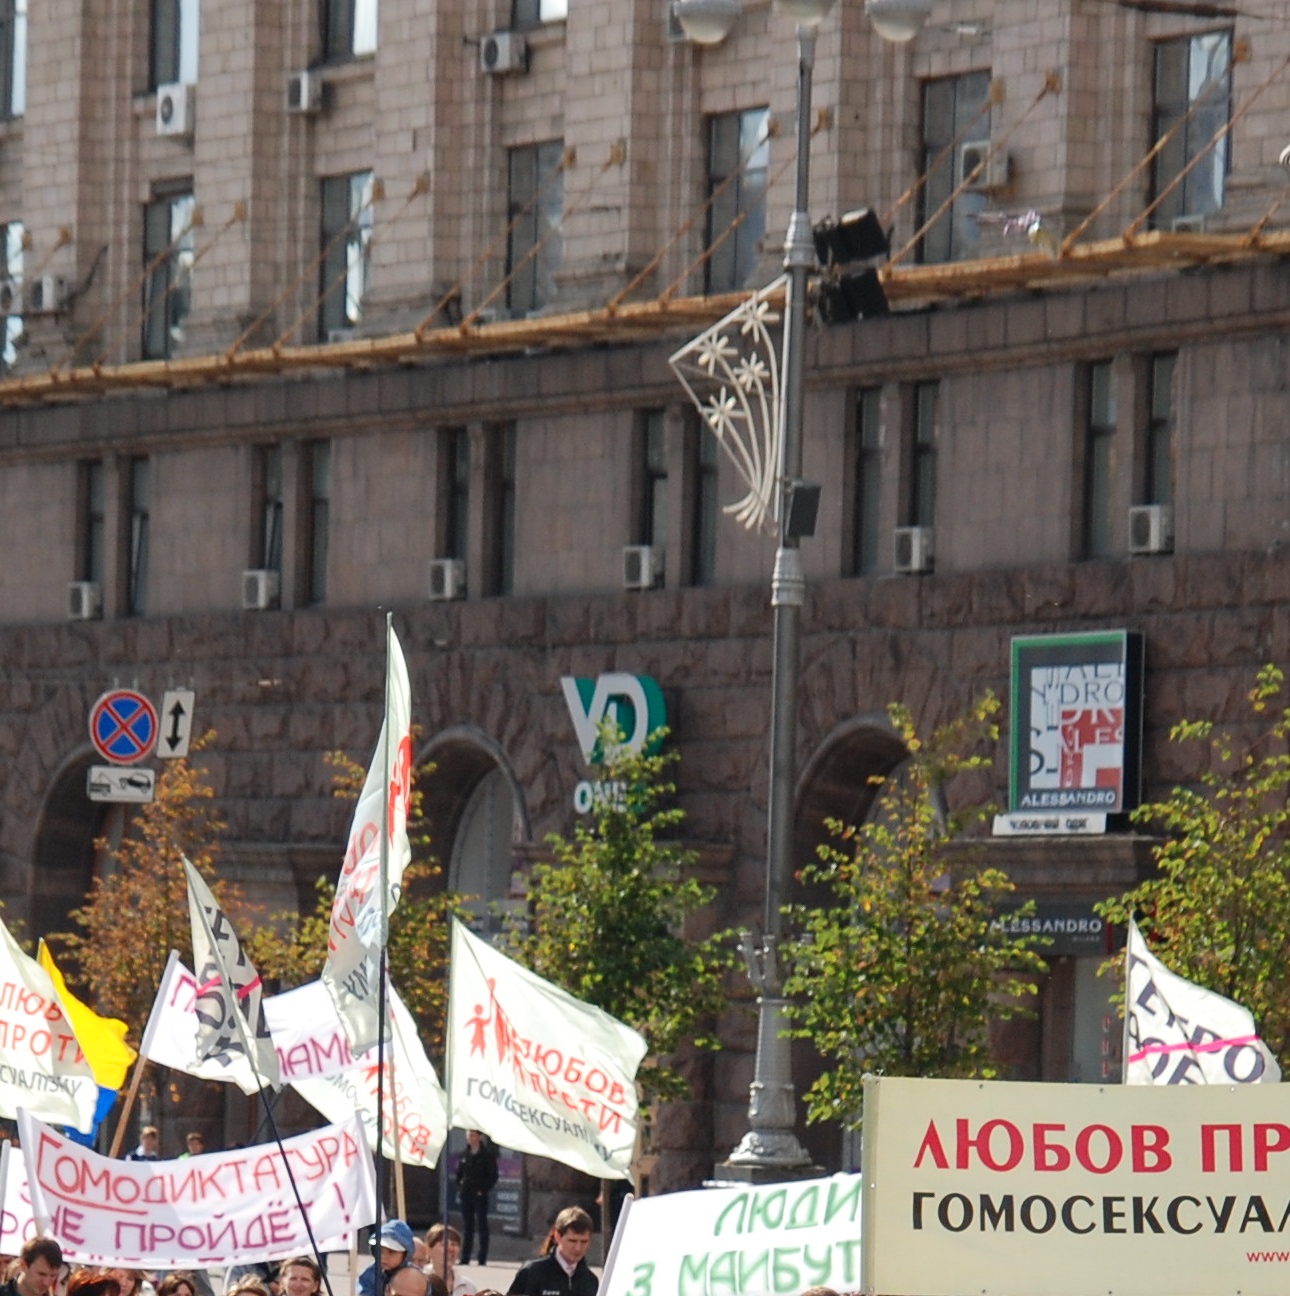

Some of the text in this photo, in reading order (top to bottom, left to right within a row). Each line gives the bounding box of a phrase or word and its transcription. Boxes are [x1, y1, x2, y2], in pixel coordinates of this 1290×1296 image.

[1020, 791, 1117, 807] ALESSANDRO
[990, 918, 1103, 933] ALESSANDRO
[913, 1118, 1173, 1175] ЛЮБОВ
[36, 1129, 360, 1214] ГОМОДИКТАТУРА
